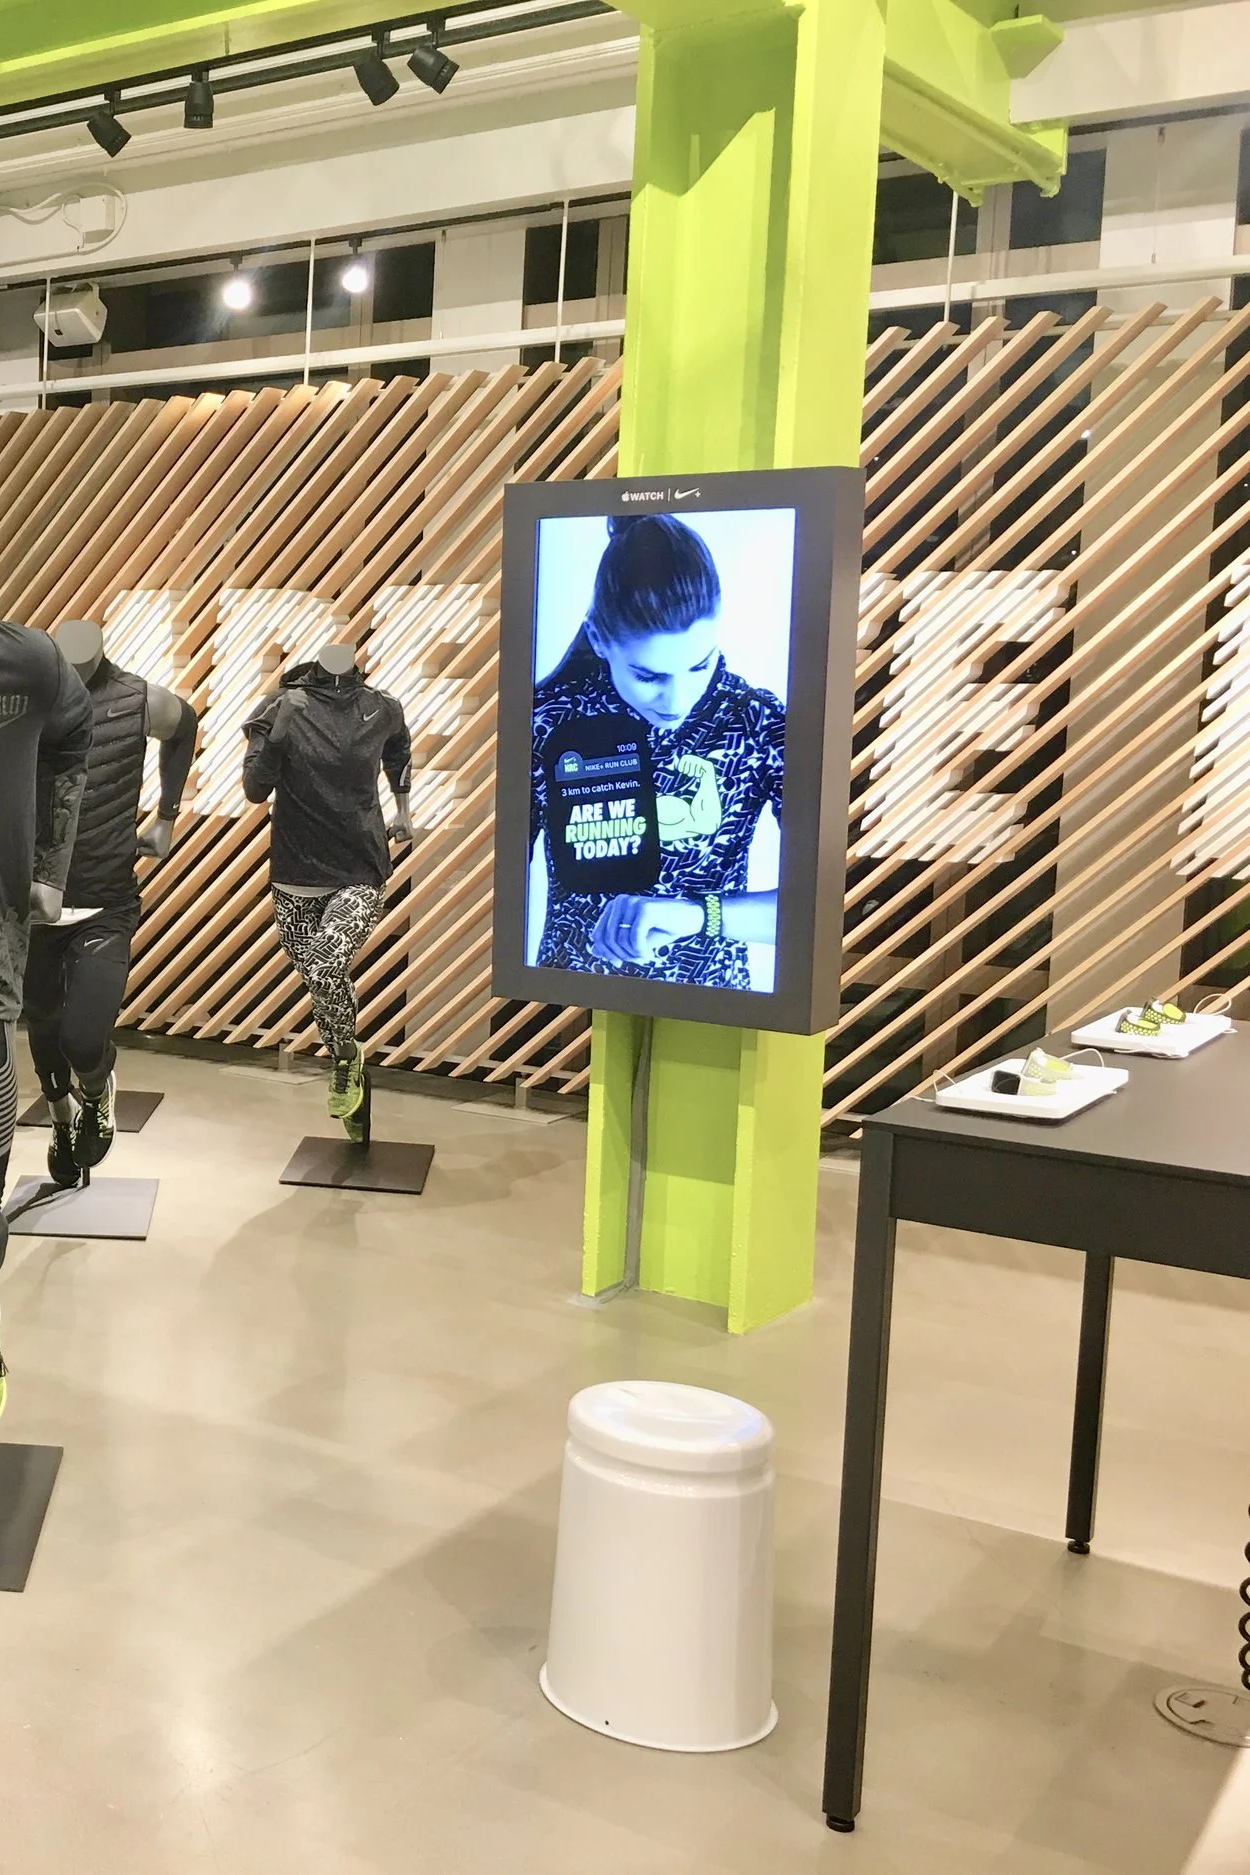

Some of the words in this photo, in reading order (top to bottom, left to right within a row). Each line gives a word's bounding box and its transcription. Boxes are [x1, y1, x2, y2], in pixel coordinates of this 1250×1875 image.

[630, 491, 664, 501] WATCH
[616, 742, 637, 753] 10:09
[564, 763, 579, 773] NRC
[604, 761, 619, 770] RUN
[620, 758, 638, 767] CLUB
[561, 788, 567, 797] 3
[568, 786, 581, 796] km
[581, 785, 590, 794] to
[591, 782, 614, 793] catch
[615, 780, 641, 790] Kevin.
[570, 802, 603, 824] ARE
[608, 798, 636, 820] WE
[565, 816, 647, 843] RUNNING
[573, 835, 642, 860] TODAY?
